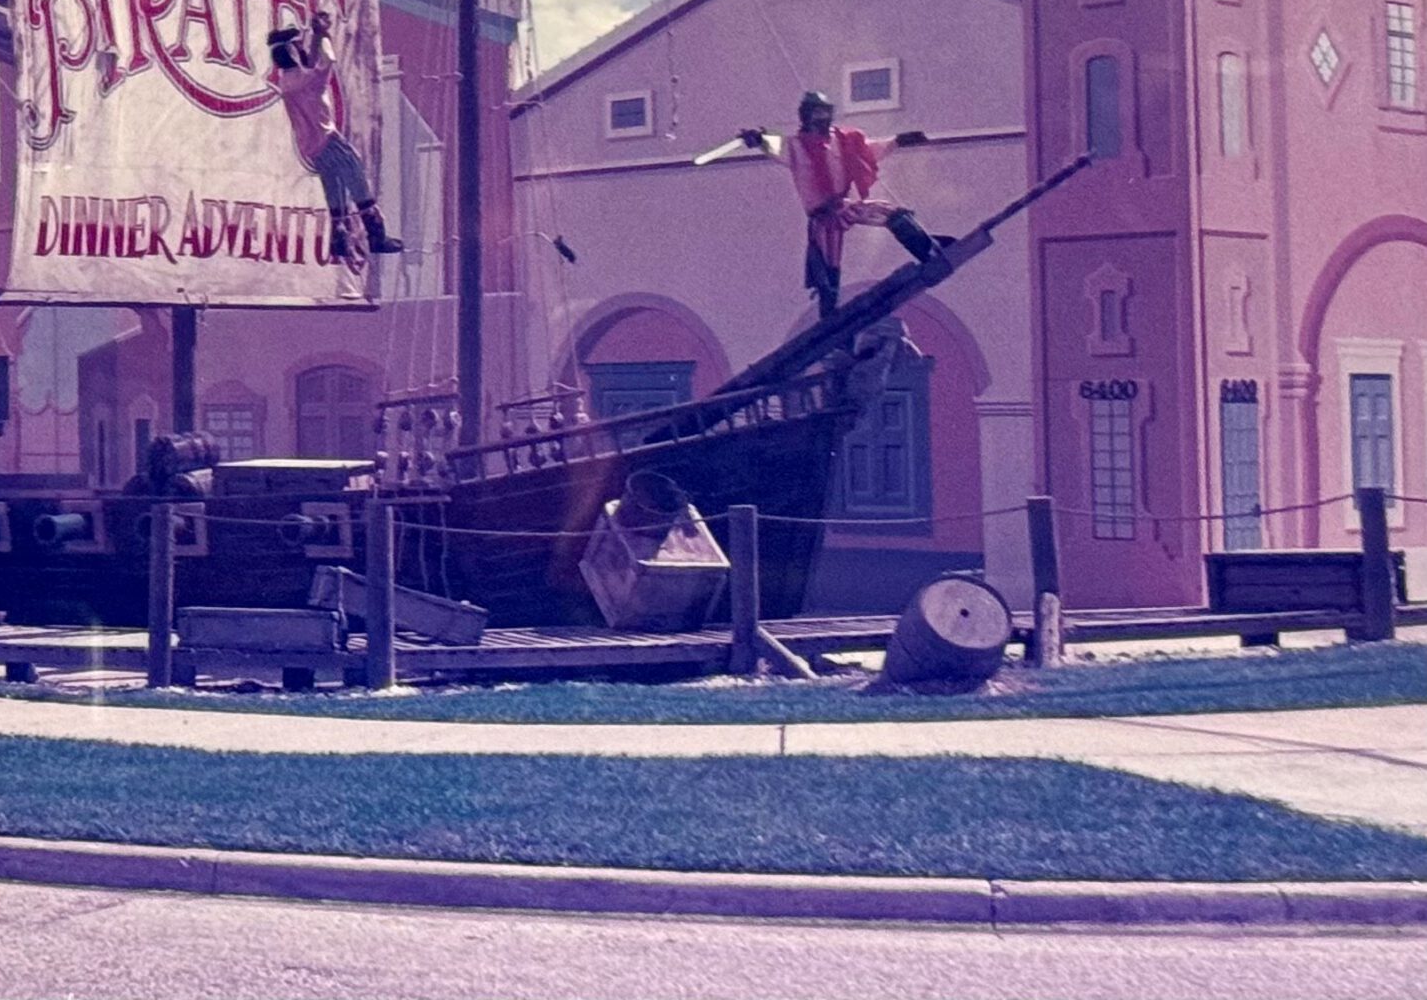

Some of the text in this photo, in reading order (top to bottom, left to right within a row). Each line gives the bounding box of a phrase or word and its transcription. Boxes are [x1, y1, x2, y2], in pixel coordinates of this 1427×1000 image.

[34, 190, 366, 275] DINNER ADVENTU
[1079, 379, 1138, 400] 6400
